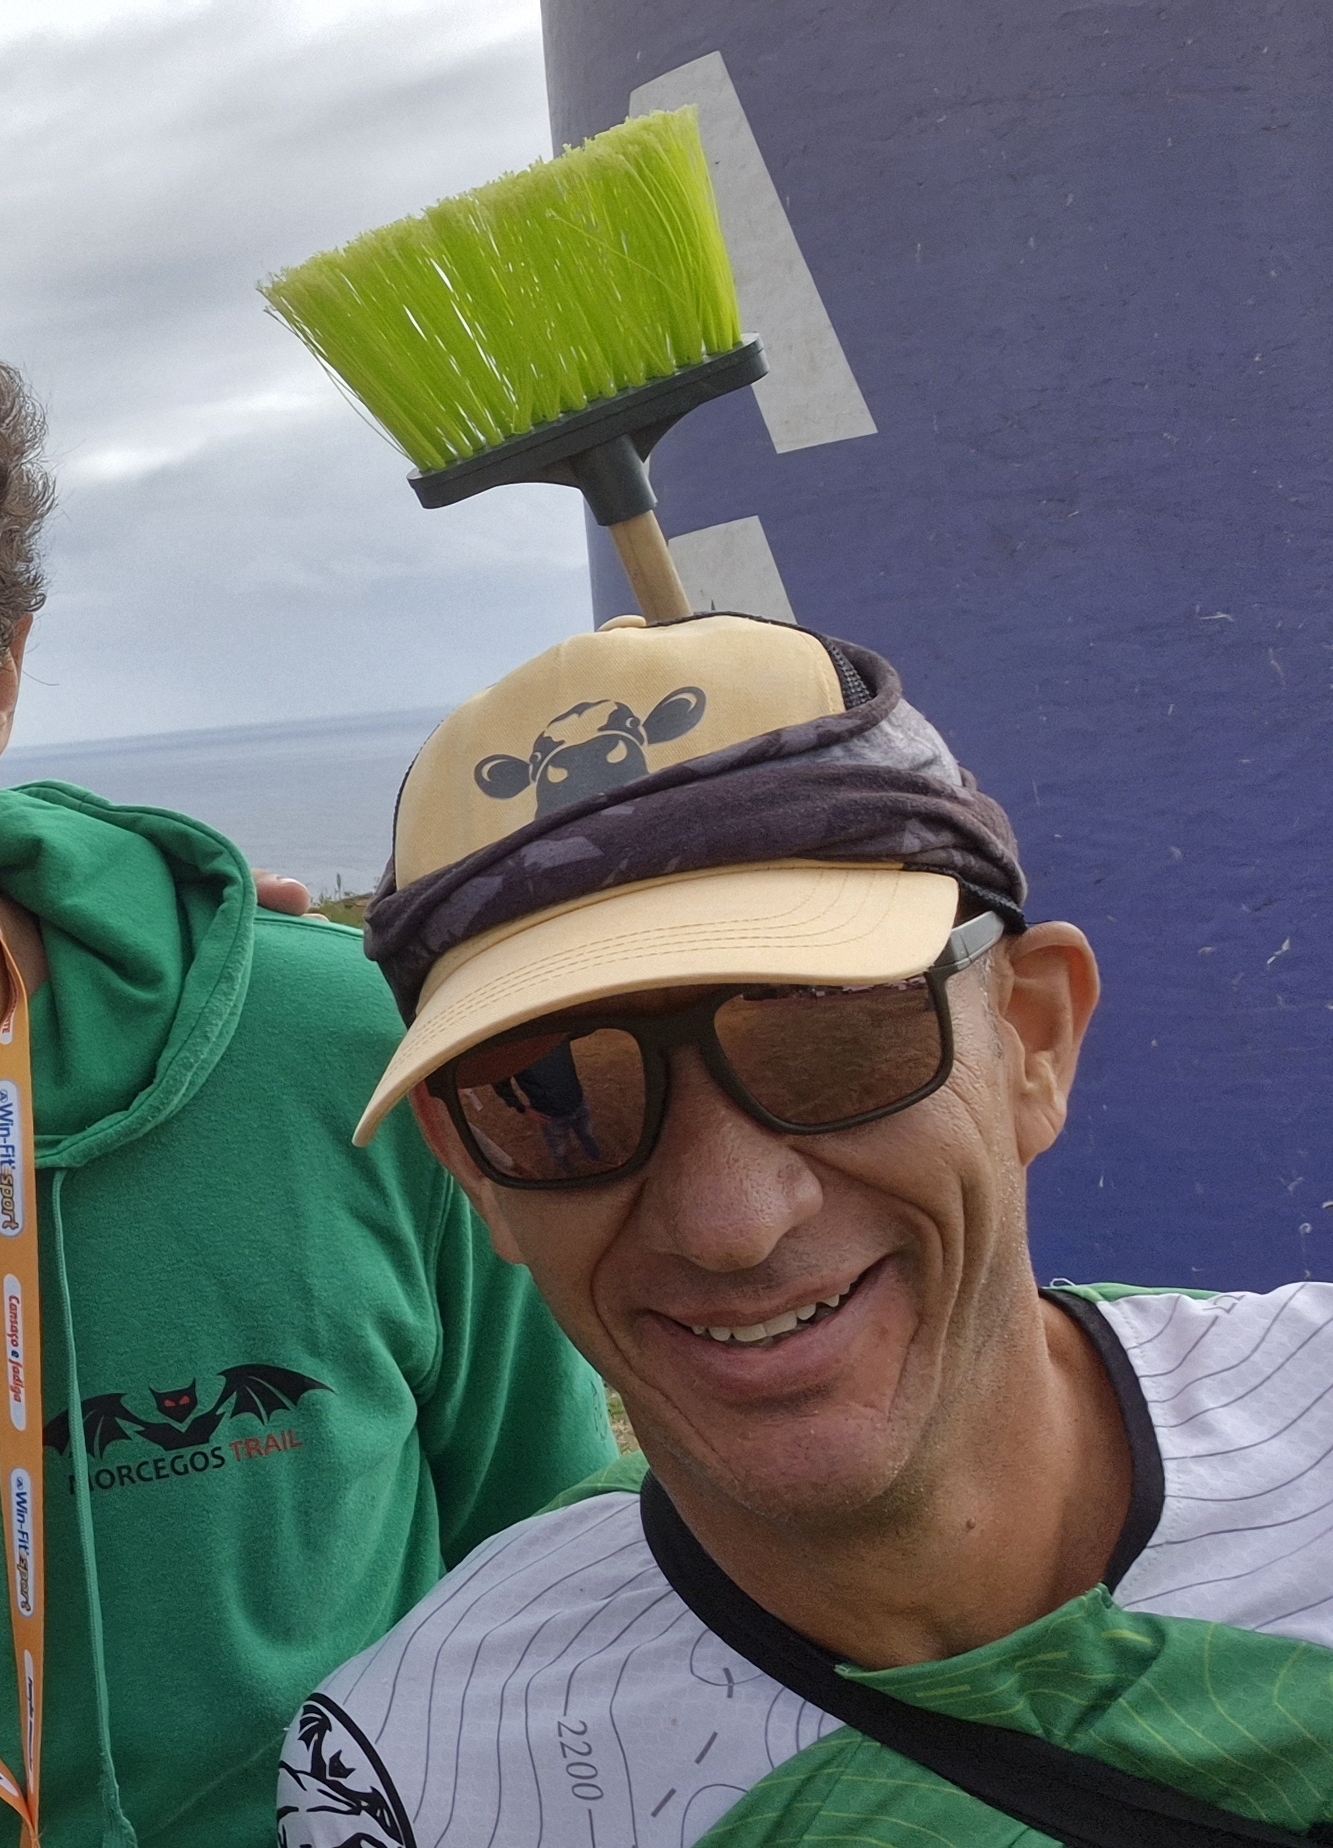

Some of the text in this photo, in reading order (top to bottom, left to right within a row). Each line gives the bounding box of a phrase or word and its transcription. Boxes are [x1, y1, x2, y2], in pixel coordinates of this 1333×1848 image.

[11, 1350, 19, 1358] e
[8, 1359, 24, 1403] fadiga
[229, 1429, 303, 1462] TRAIL
[557, 1720, 604, 1801] 2200
